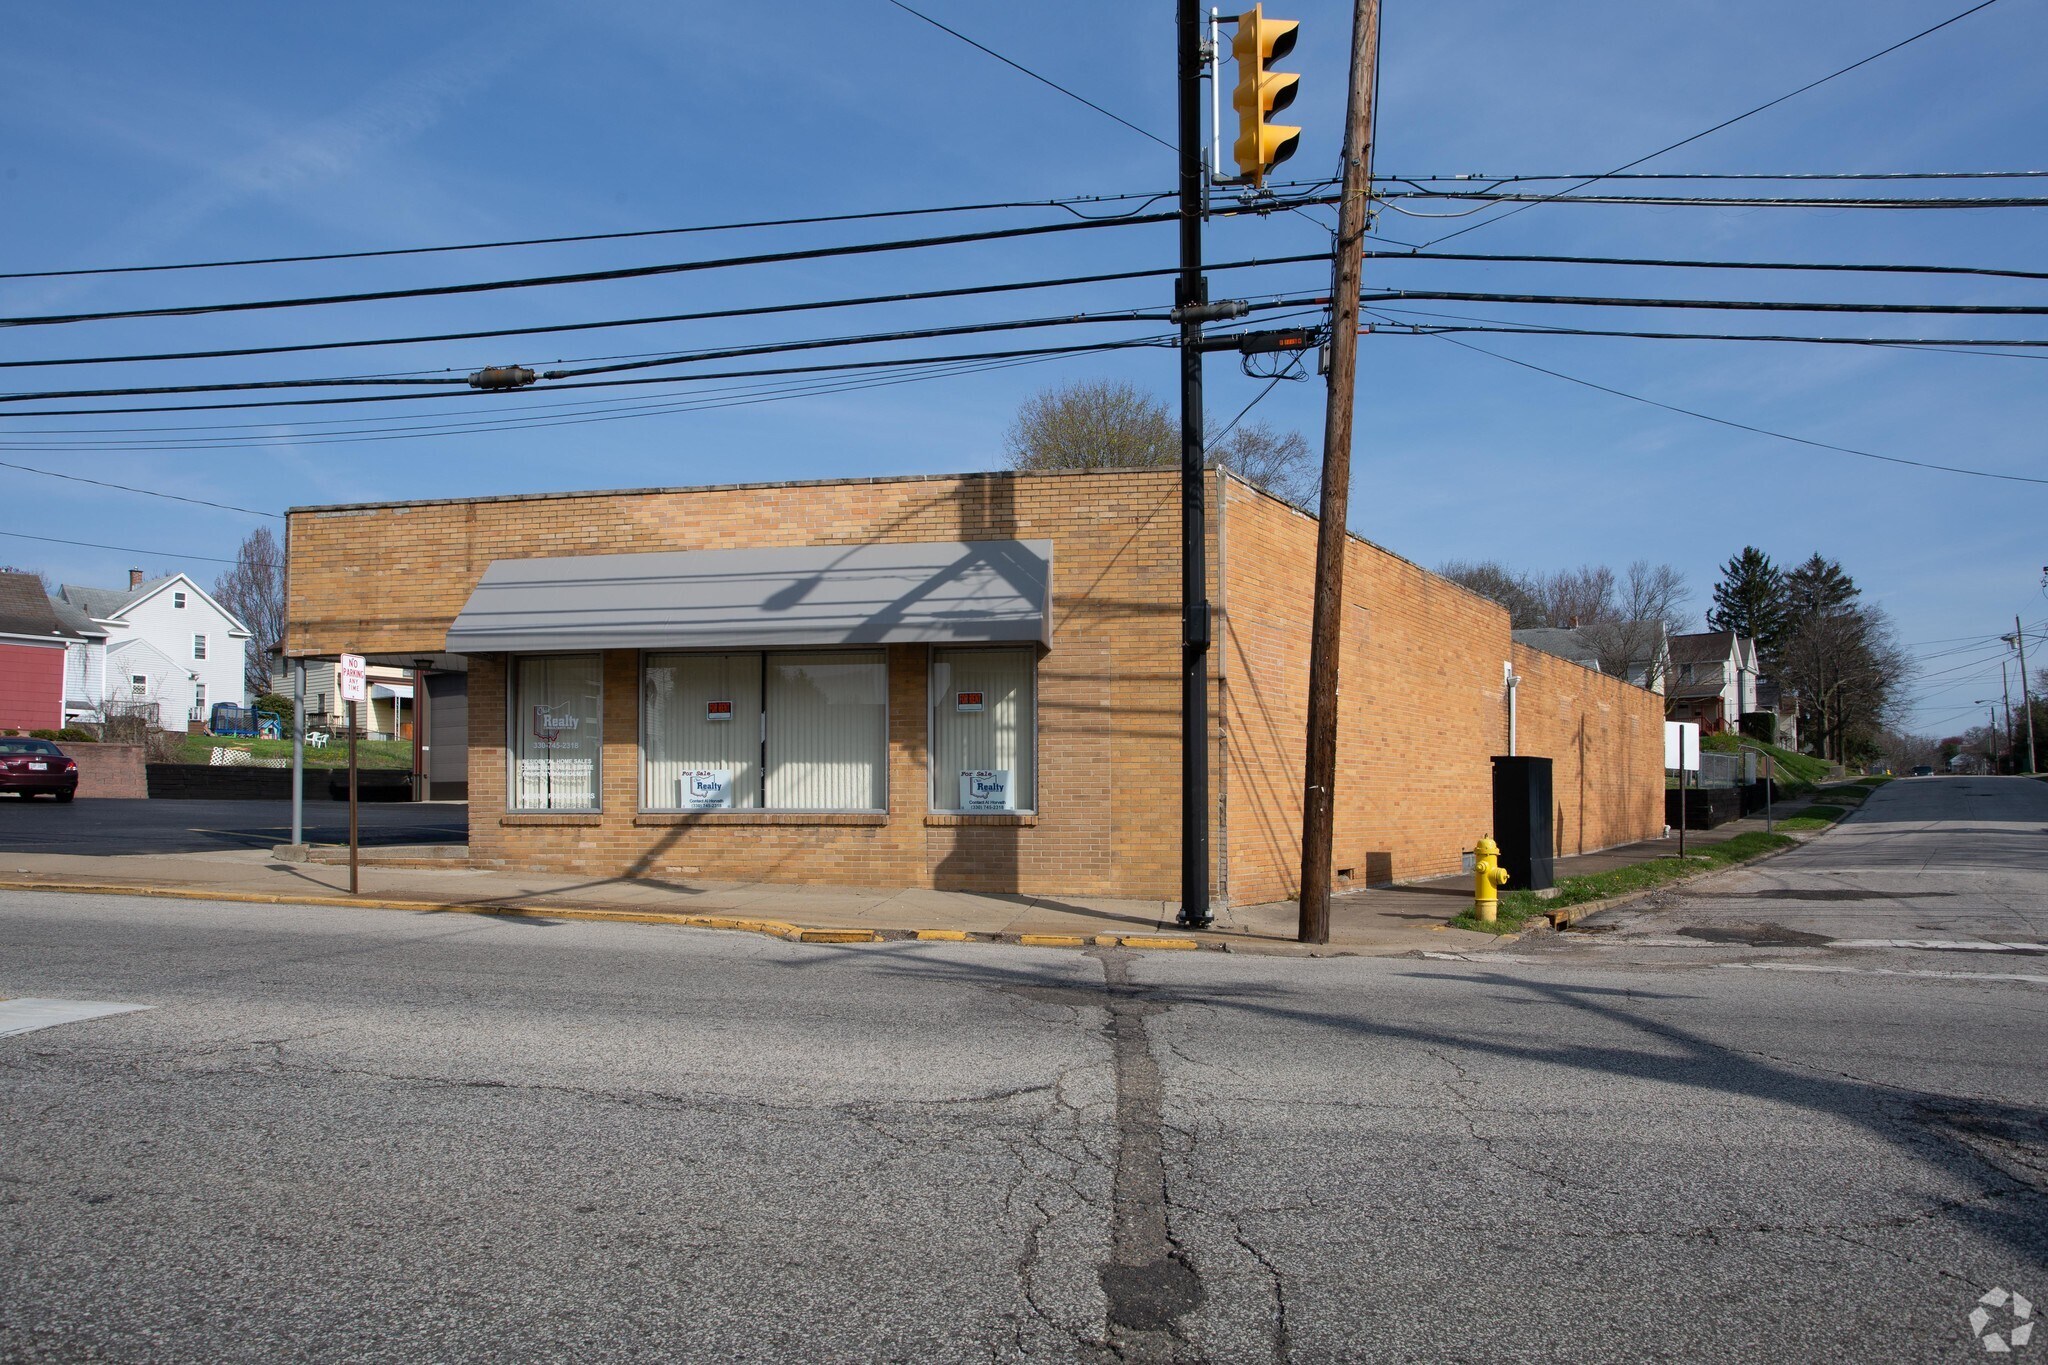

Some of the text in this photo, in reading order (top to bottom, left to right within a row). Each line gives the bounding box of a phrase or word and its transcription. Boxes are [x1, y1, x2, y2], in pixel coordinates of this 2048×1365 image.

[348, 658, 358, 668] NO
[344, 668, 364, 678] PARKING
[544, 714, 579, 730] Realty
[697, 782, 722, 791] Realty
[977, 783, 1004, 792] Realty
